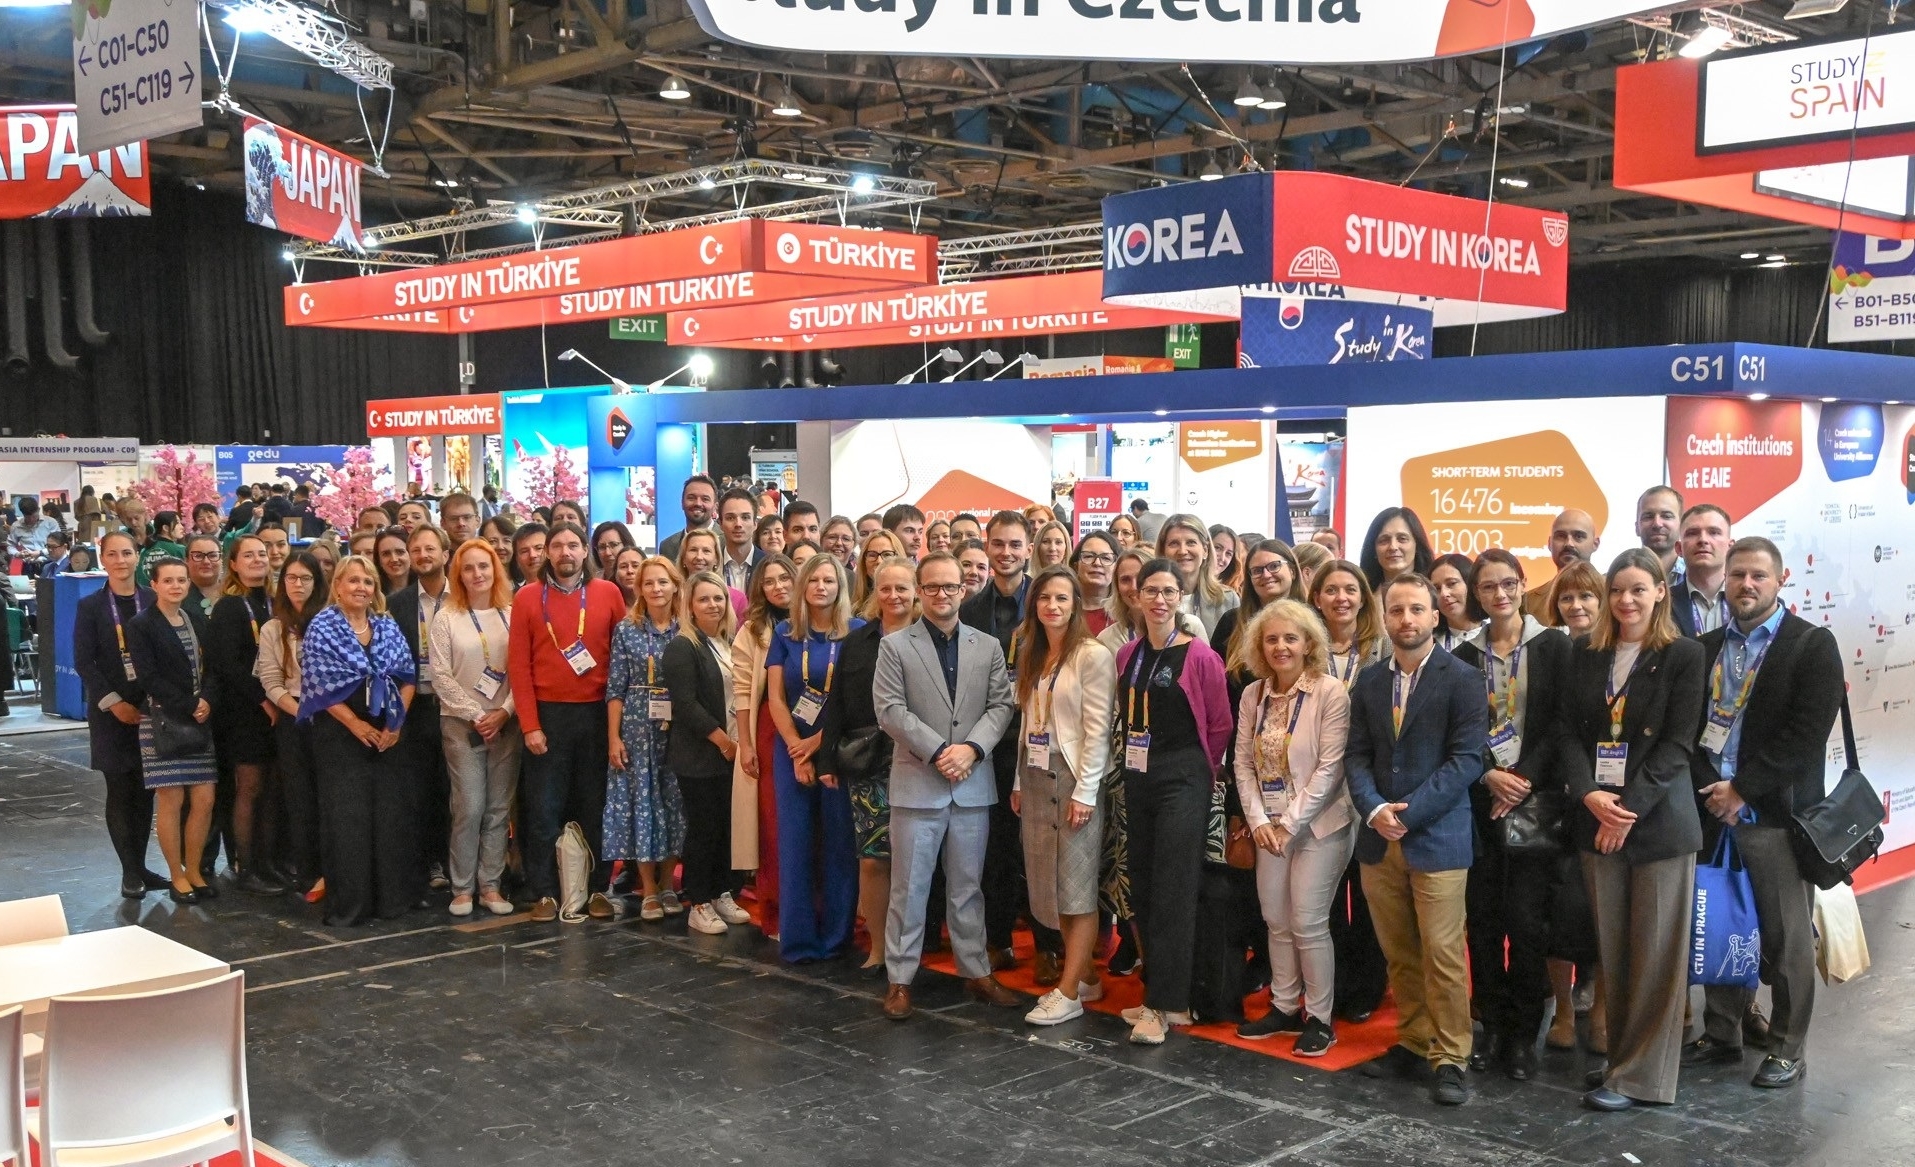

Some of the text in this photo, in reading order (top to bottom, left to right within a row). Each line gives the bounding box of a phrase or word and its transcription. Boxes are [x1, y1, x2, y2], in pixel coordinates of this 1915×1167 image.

[99, 19, 169, 69] C01-C50
[1791, 55, 1860, 84] STUDY
[100, 69, 172, 116] C51-C119
[1790, 76, 1885, 119] SPAIN
[284, 139, 361, 222] JAPAN
[1107, 208, 1244, 271] KOREA
[1346, 214, 1541, 276] STUDY IN KOREA
[809, 237, 916, 271] TÜRKİYE
[395, 255, 580, 306] STUDY IN TÜRKİYE
[560, 288, 624, 315] STUDY
[630, 284, 652, 308] IN
[789, 288, 988, 330] STUDY IN TÜRKİYE
[619, 318, 658, 333] EXIT
[1383, 315, 1393, 336] in
[1173, 348, 1192, 360] EXIT
[1739, 354, 1765, 381] C51
[1671, 355, 1723, 382] C51
[385, 411, 424, 427] STUDY
[425, 409, 438, 426] IN
[21, 446, 71, 454] INTERNSHIP
[73, 446, 115, 454] PROGRAM
[121, 446, 136, 454] C09
[1686, 432, 1793, 456] Czech institutions
[1823, 428, 1833, 446] 14
[248, 448, 280, 462] gedu
[1431, 465, 1564, 479] SHORT-TERM STUDENTS
[1685, 466, 1731, 489] at EAIE
[1087, 497, 1110, 509] B27
[1695, 889, 1707, 975] CTU IN PRAGUE
